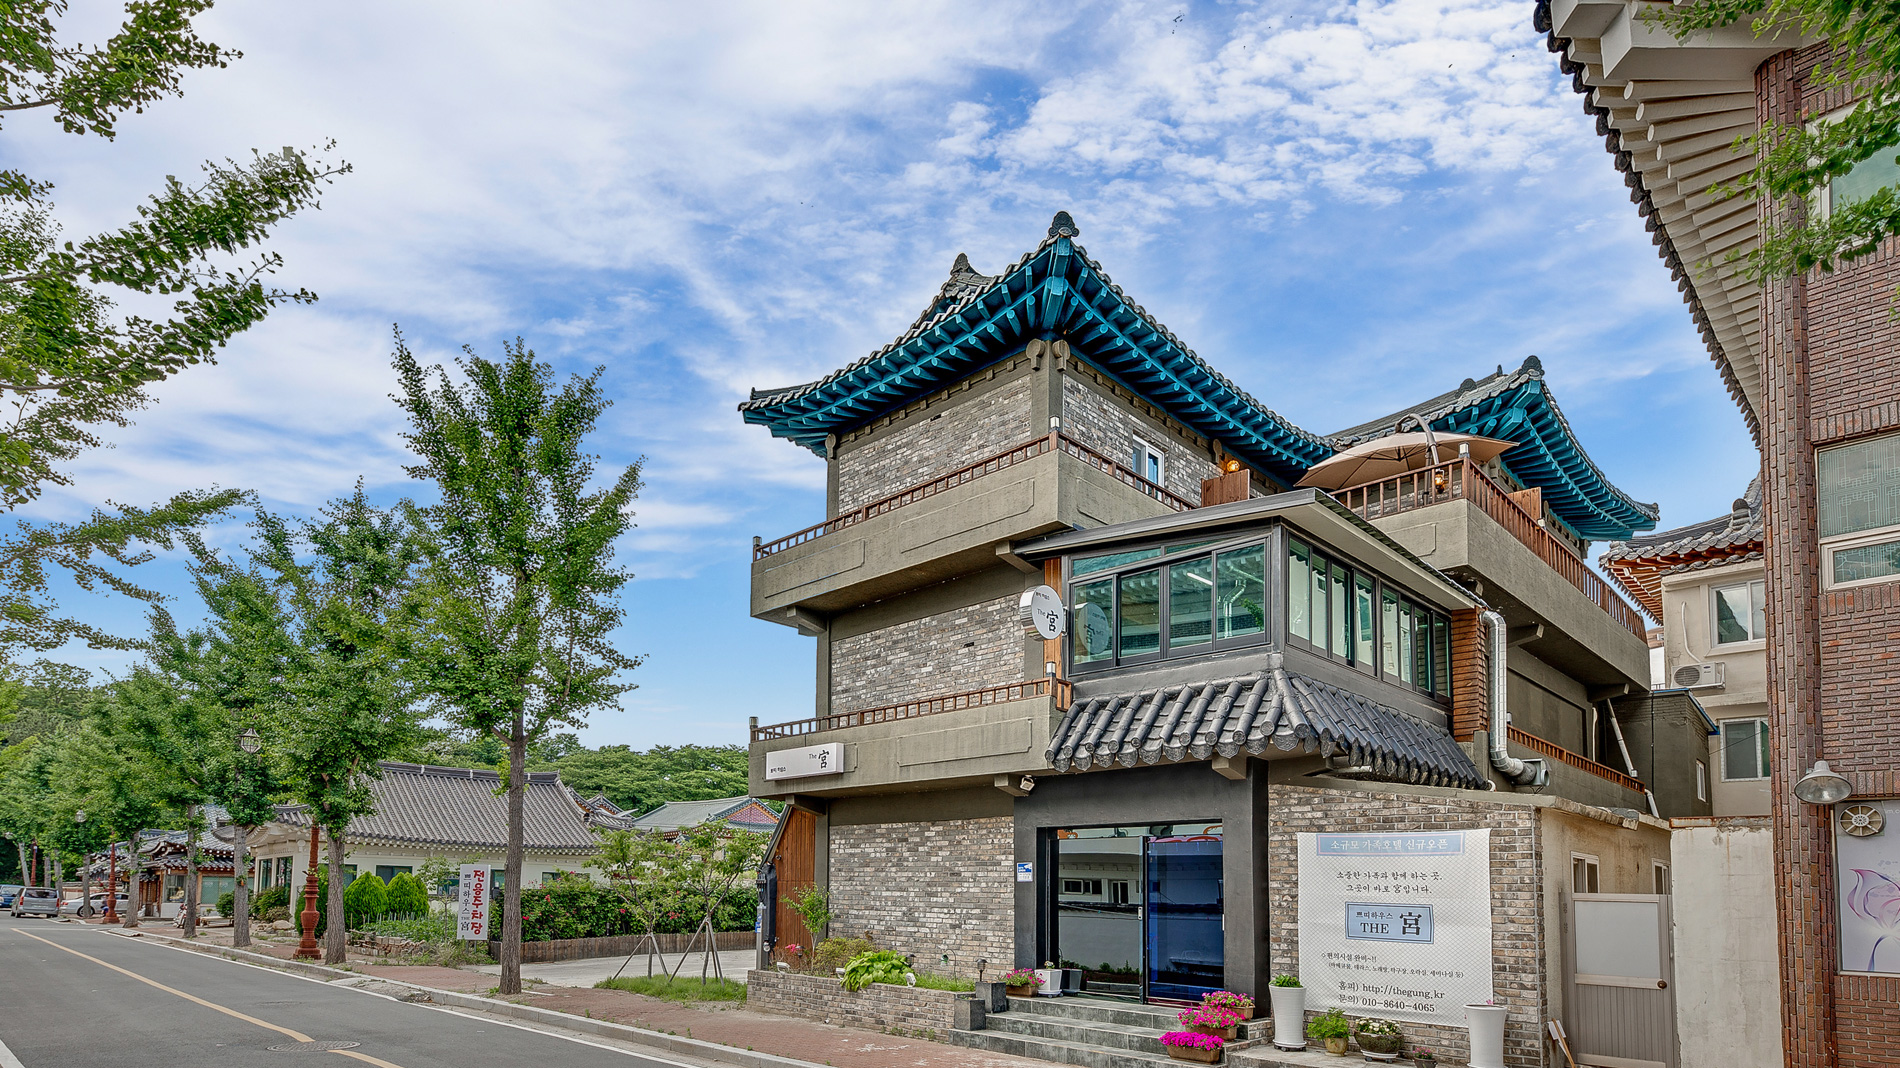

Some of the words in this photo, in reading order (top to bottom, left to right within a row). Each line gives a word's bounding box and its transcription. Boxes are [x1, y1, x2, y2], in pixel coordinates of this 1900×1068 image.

[1046, 610, 1059, 632] 宮
[818, 750, 829, 769] 宮
[1330, 840, 1359, 850] 소규모
[1362, 839, 1402, 851] 가족호텔
[1405, 839, 1448, 850] 신규오픈
[1337, 871, 1360, 879] 소중한
[1363, 871, 1388, 880] 가족과
[1391, 871, 1407, 880] 함께
[1411, 872, 1428, 880] 하는
[1346, 884, 1370, 892] 그곳이
[1373, 884, 1390, 893] 바로
[471, 870, 485, 935] 전용주차장
[1356, 911, 1393, 919] 쁘띠하우스
[1360, 922, 1389, 934] THE
[1399, 911, 1422, 935] 宮
[1339, 981, 1359, 992] 홈피)
[1362, 984, 1445, 999] http://thegung.kr
[1339, 994, 1359, 1004] 문의)
[1362, 998, 1435, 1012] 010-8640-4065
